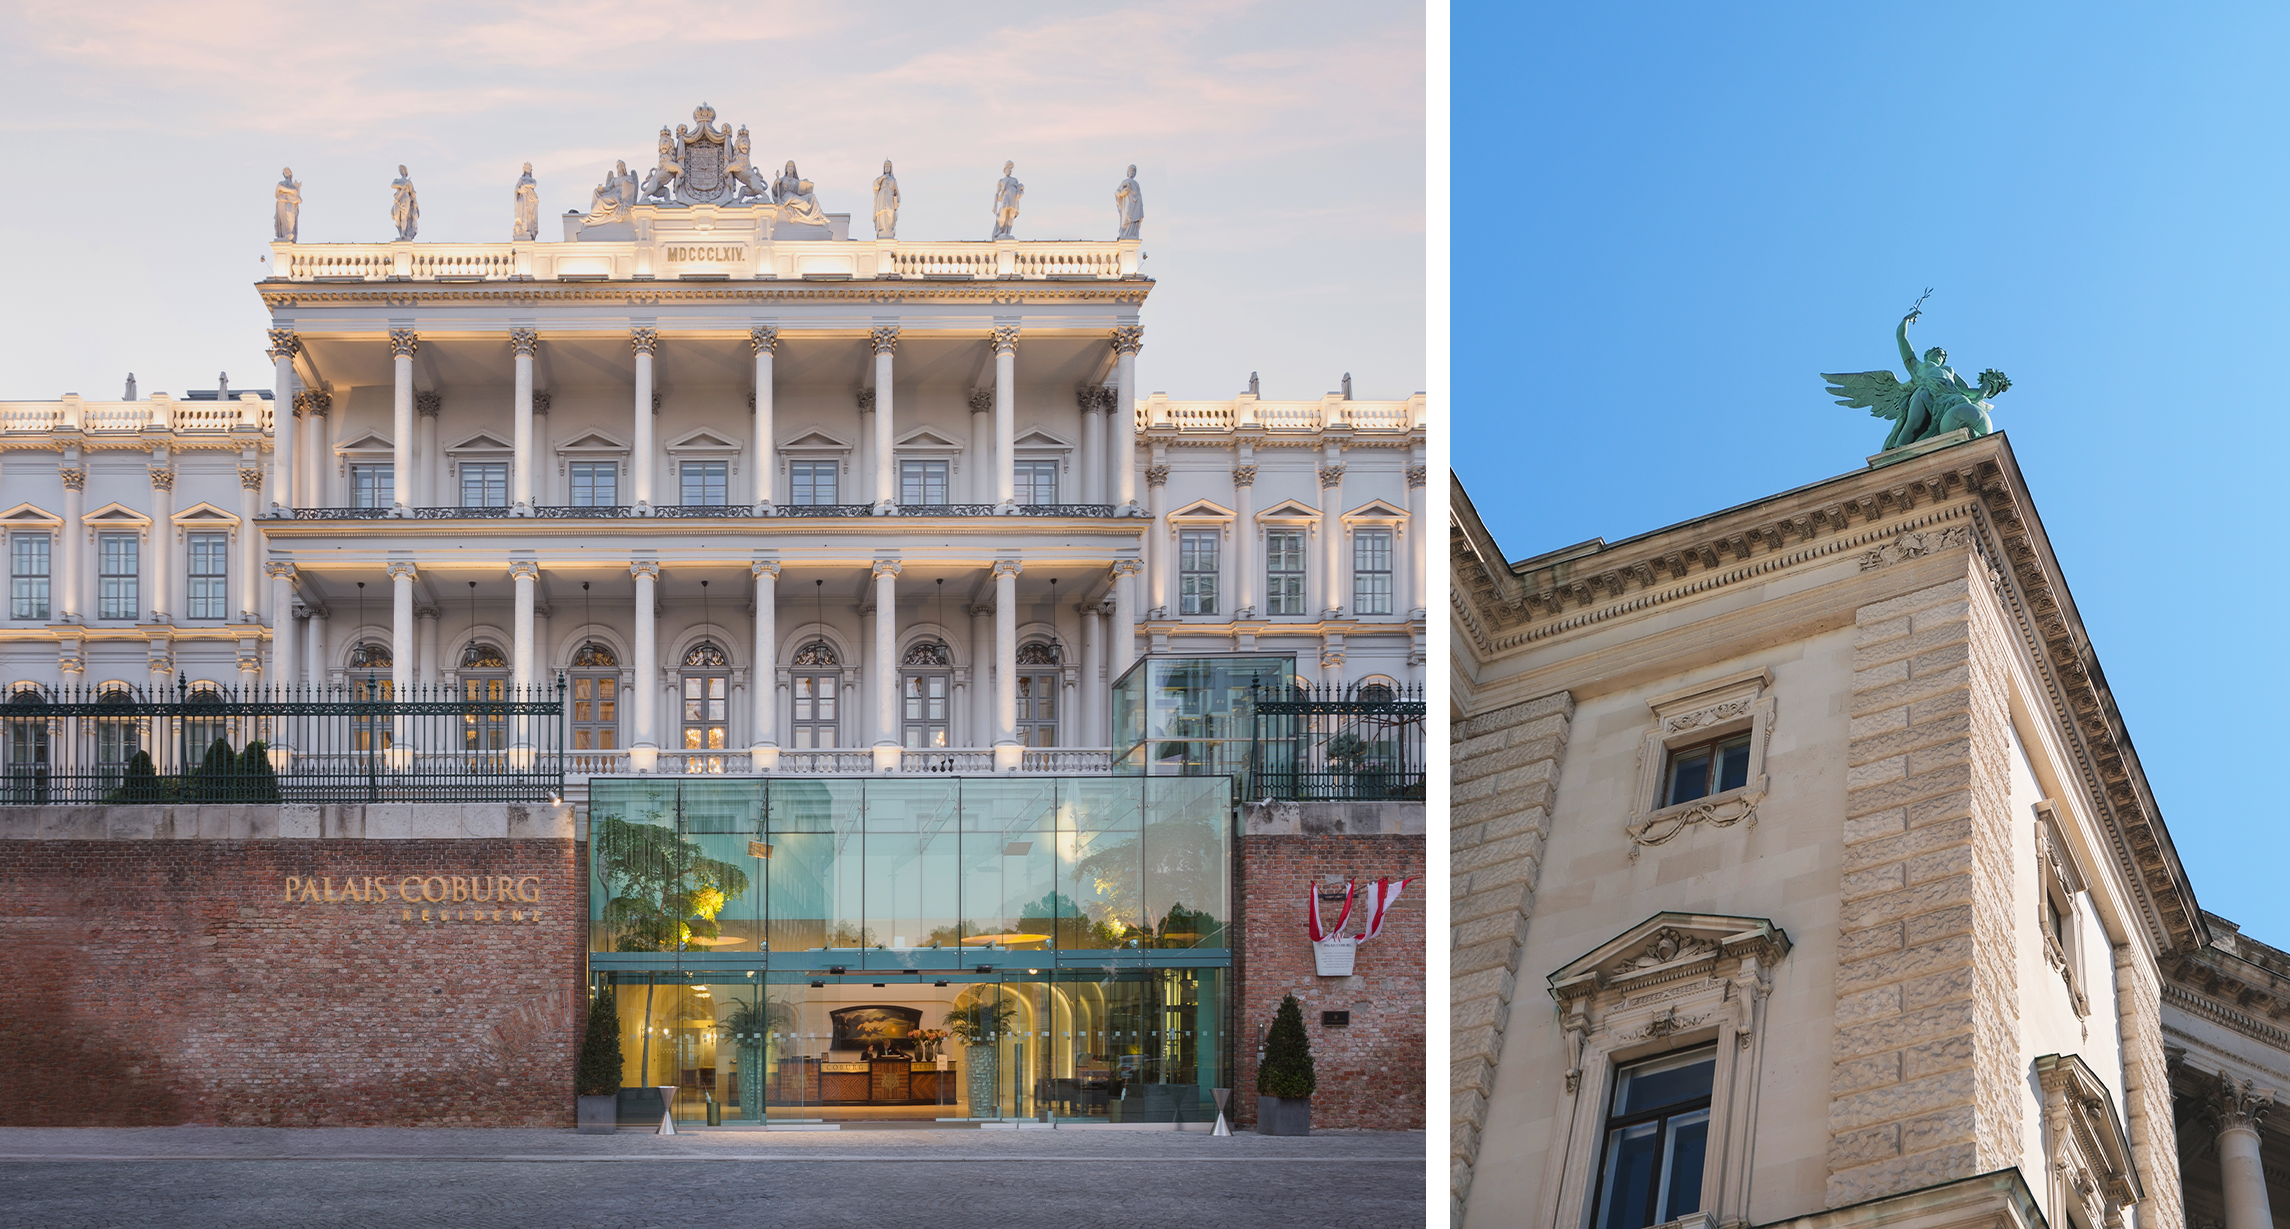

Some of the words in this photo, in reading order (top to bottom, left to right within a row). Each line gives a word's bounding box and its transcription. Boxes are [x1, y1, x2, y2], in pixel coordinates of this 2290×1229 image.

[667, 246, 746, 262] MDCCCLXIV.
[285, 876, 387, 902] PALAIS
[400, 876, 541, 902] COBURG
[403, 910, 540, 922] RESIDENZ
